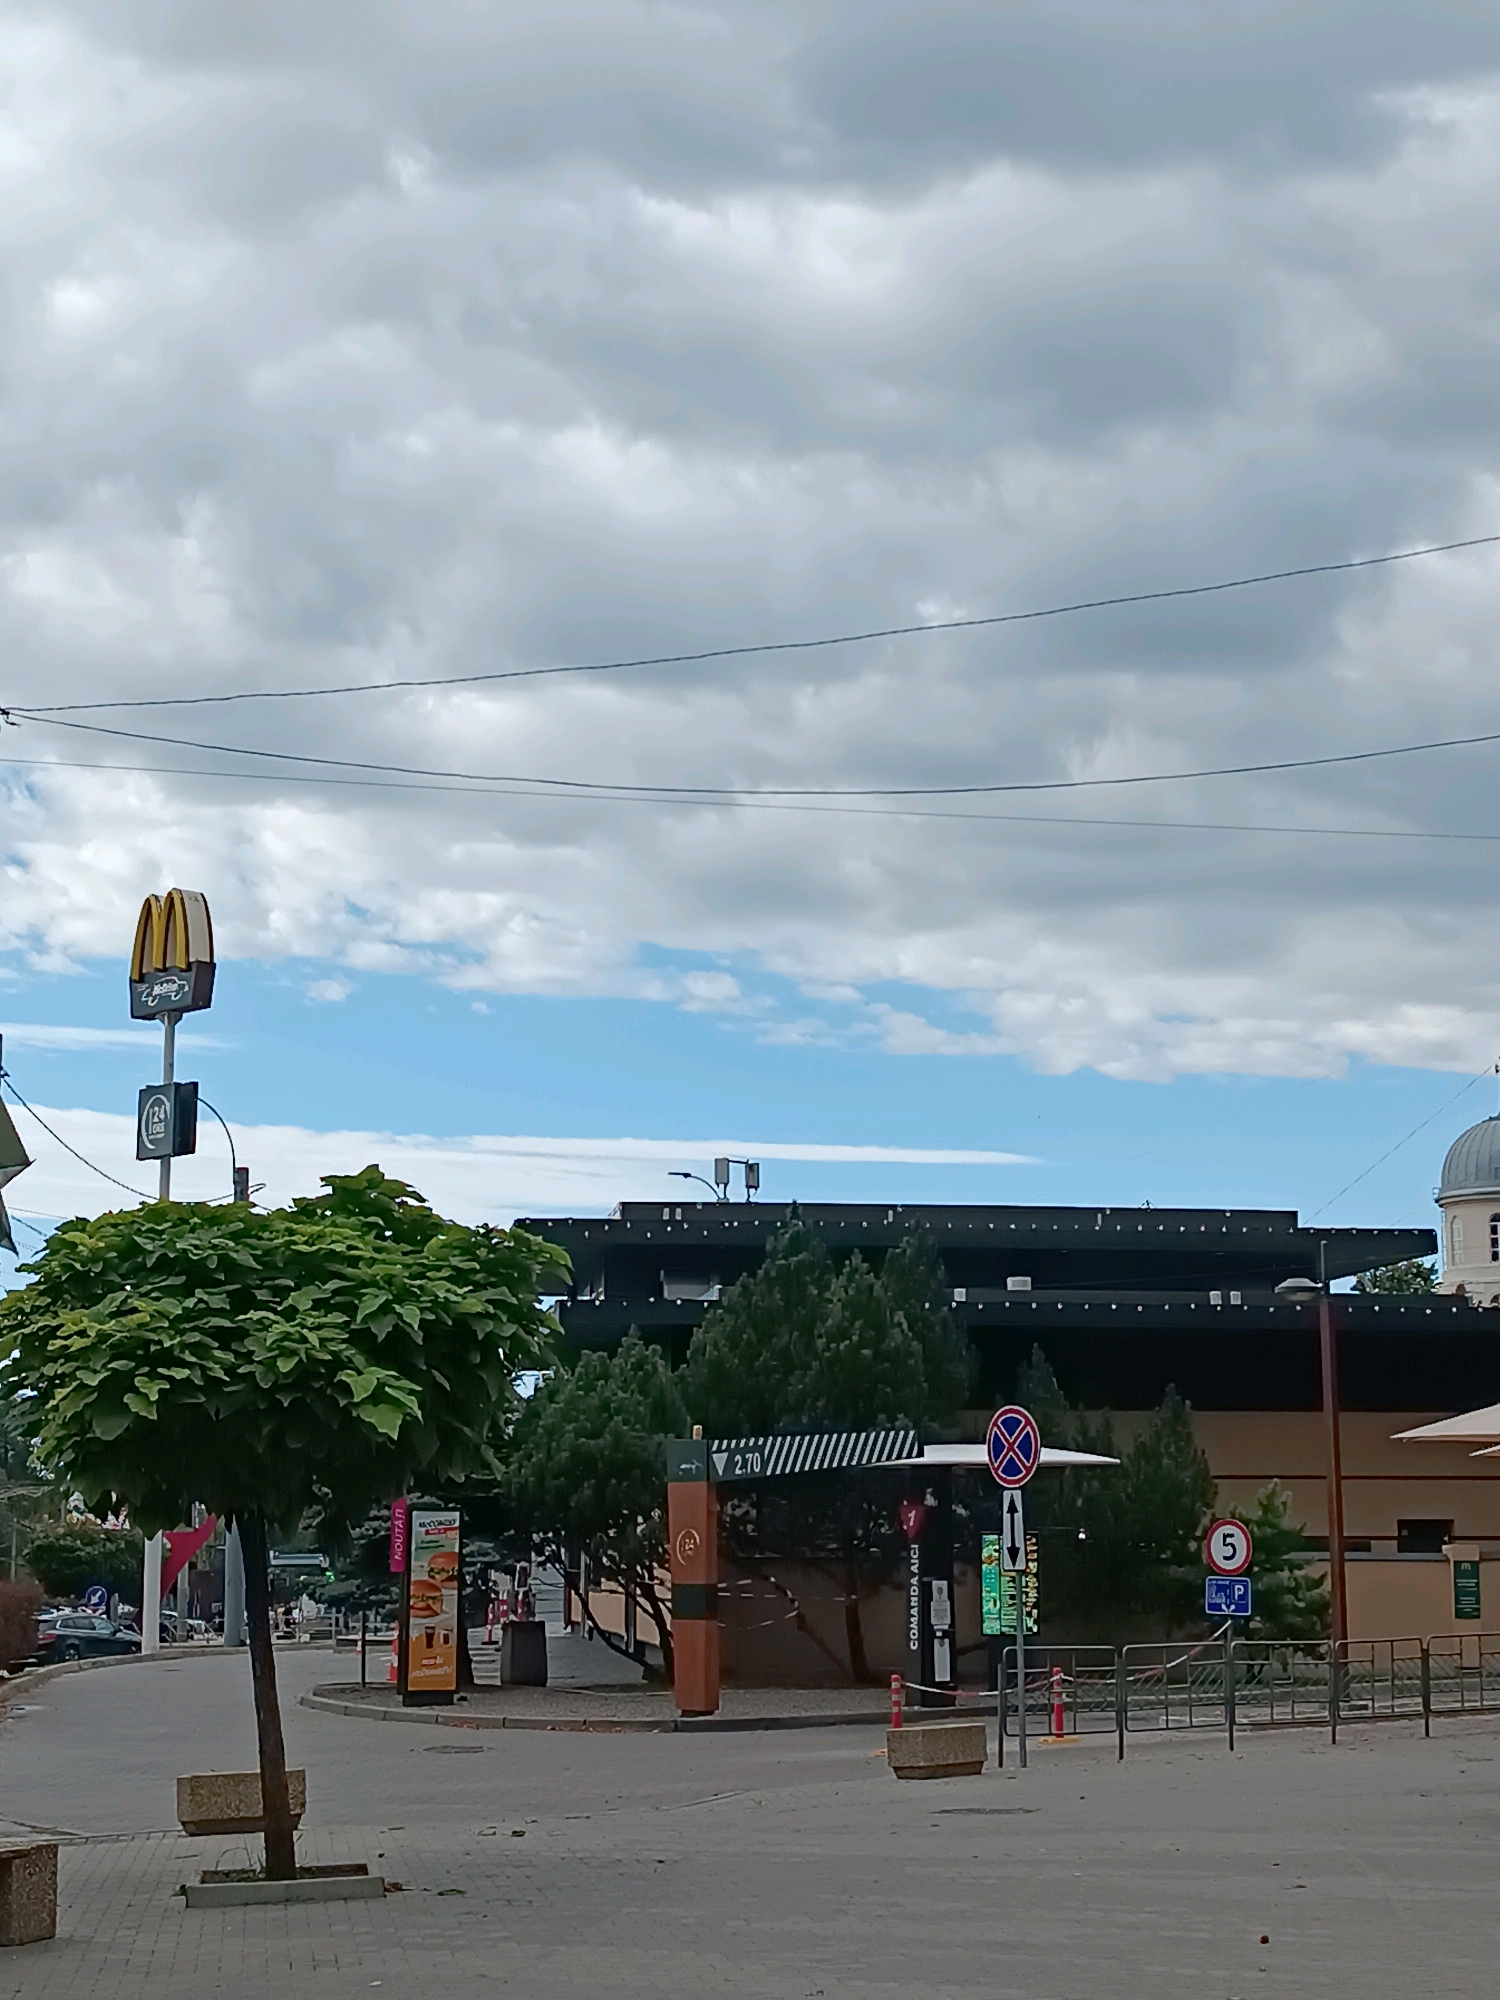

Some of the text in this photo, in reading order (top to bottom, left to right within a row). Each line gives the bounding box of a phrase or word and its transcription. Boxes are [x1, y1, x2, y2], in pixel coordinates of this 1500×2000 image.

[152, 1104, 165, 1123] 24
[734, 1452, 761, 1475] 2.70
[907, 1509, 916, 1526] 1
[1222, 1532, 1237, 1561] 5
[909, 1544, 920, 1650] COMANDA AICI
[1234, 1584, 1245, 1601] P
